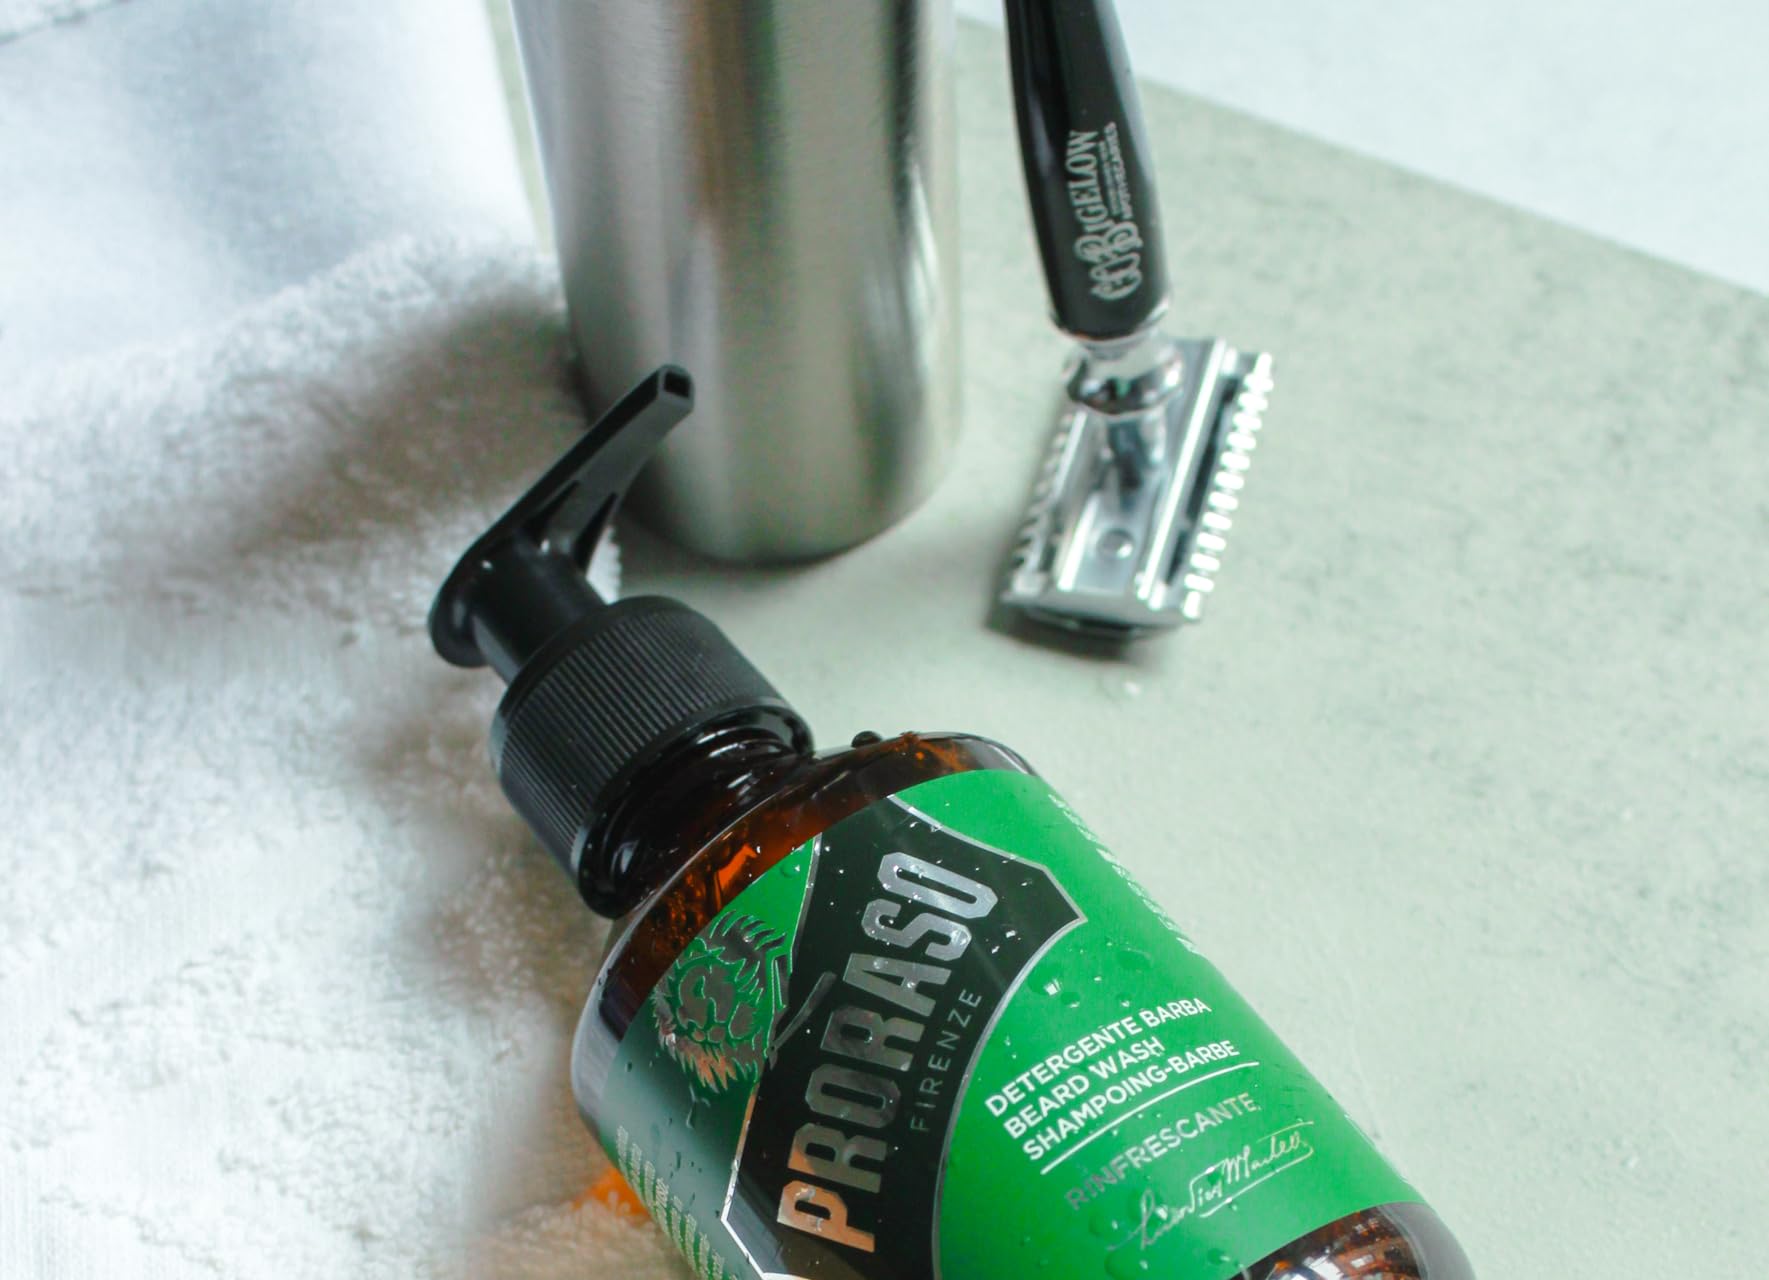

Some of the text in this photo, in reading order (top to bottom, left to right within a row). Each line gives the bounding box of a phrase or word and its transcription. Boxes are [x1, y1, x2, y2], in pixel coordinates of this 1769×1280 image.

[777, 851, 999, 1253] PRORASO
[911, 991, 982, 1133] FIRENZE
[984, 998, 1212, 1117] DETERGENTE BARBA
[1003, 1036, 1166, 1140] BEARD WASH
[1022, 1040, 1240, 1161] SHAMPOING-BARBE
[1065, 1092, 1261, 1211] RINFRESCANTE
